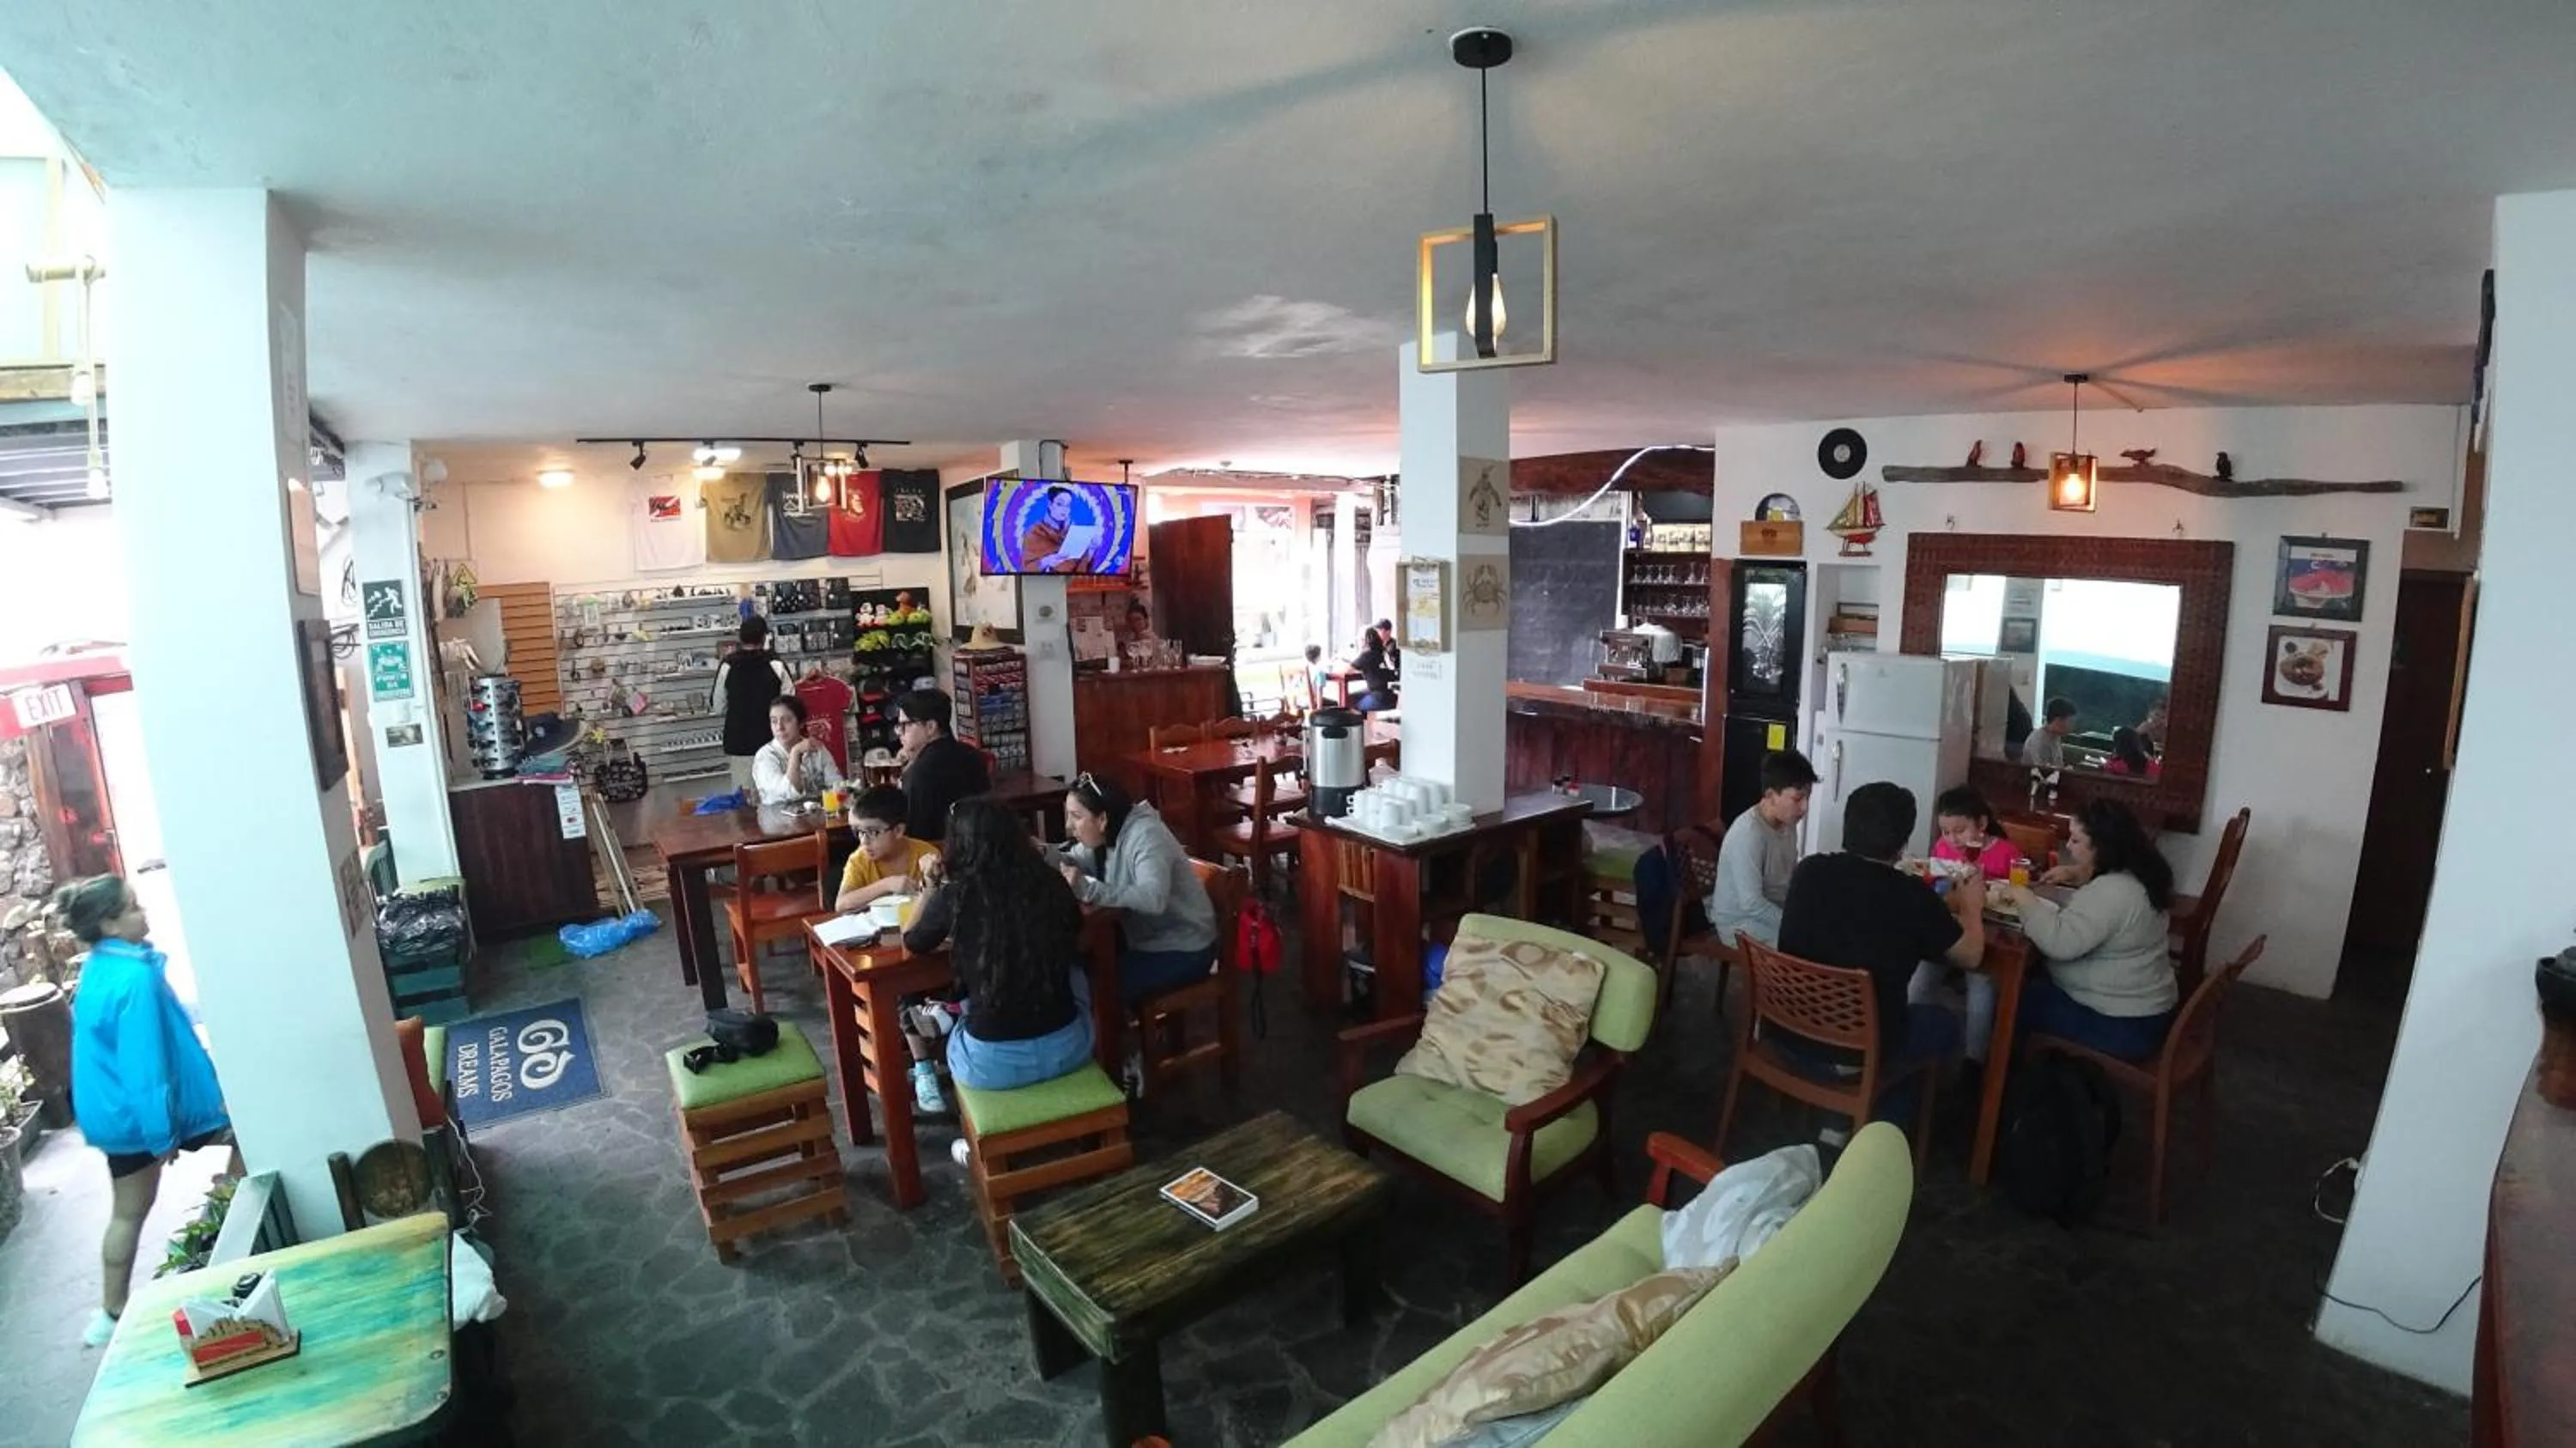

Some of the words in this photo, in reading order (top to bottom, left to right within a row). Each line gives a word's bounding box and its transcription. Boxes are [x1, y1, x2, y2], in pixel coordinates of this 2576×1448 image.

[26, 689, 63, 720] EXIT
[457, 1043, 479, 1099] DREAMS
[489, 1026, 513, 1102] GALAPAGOS
